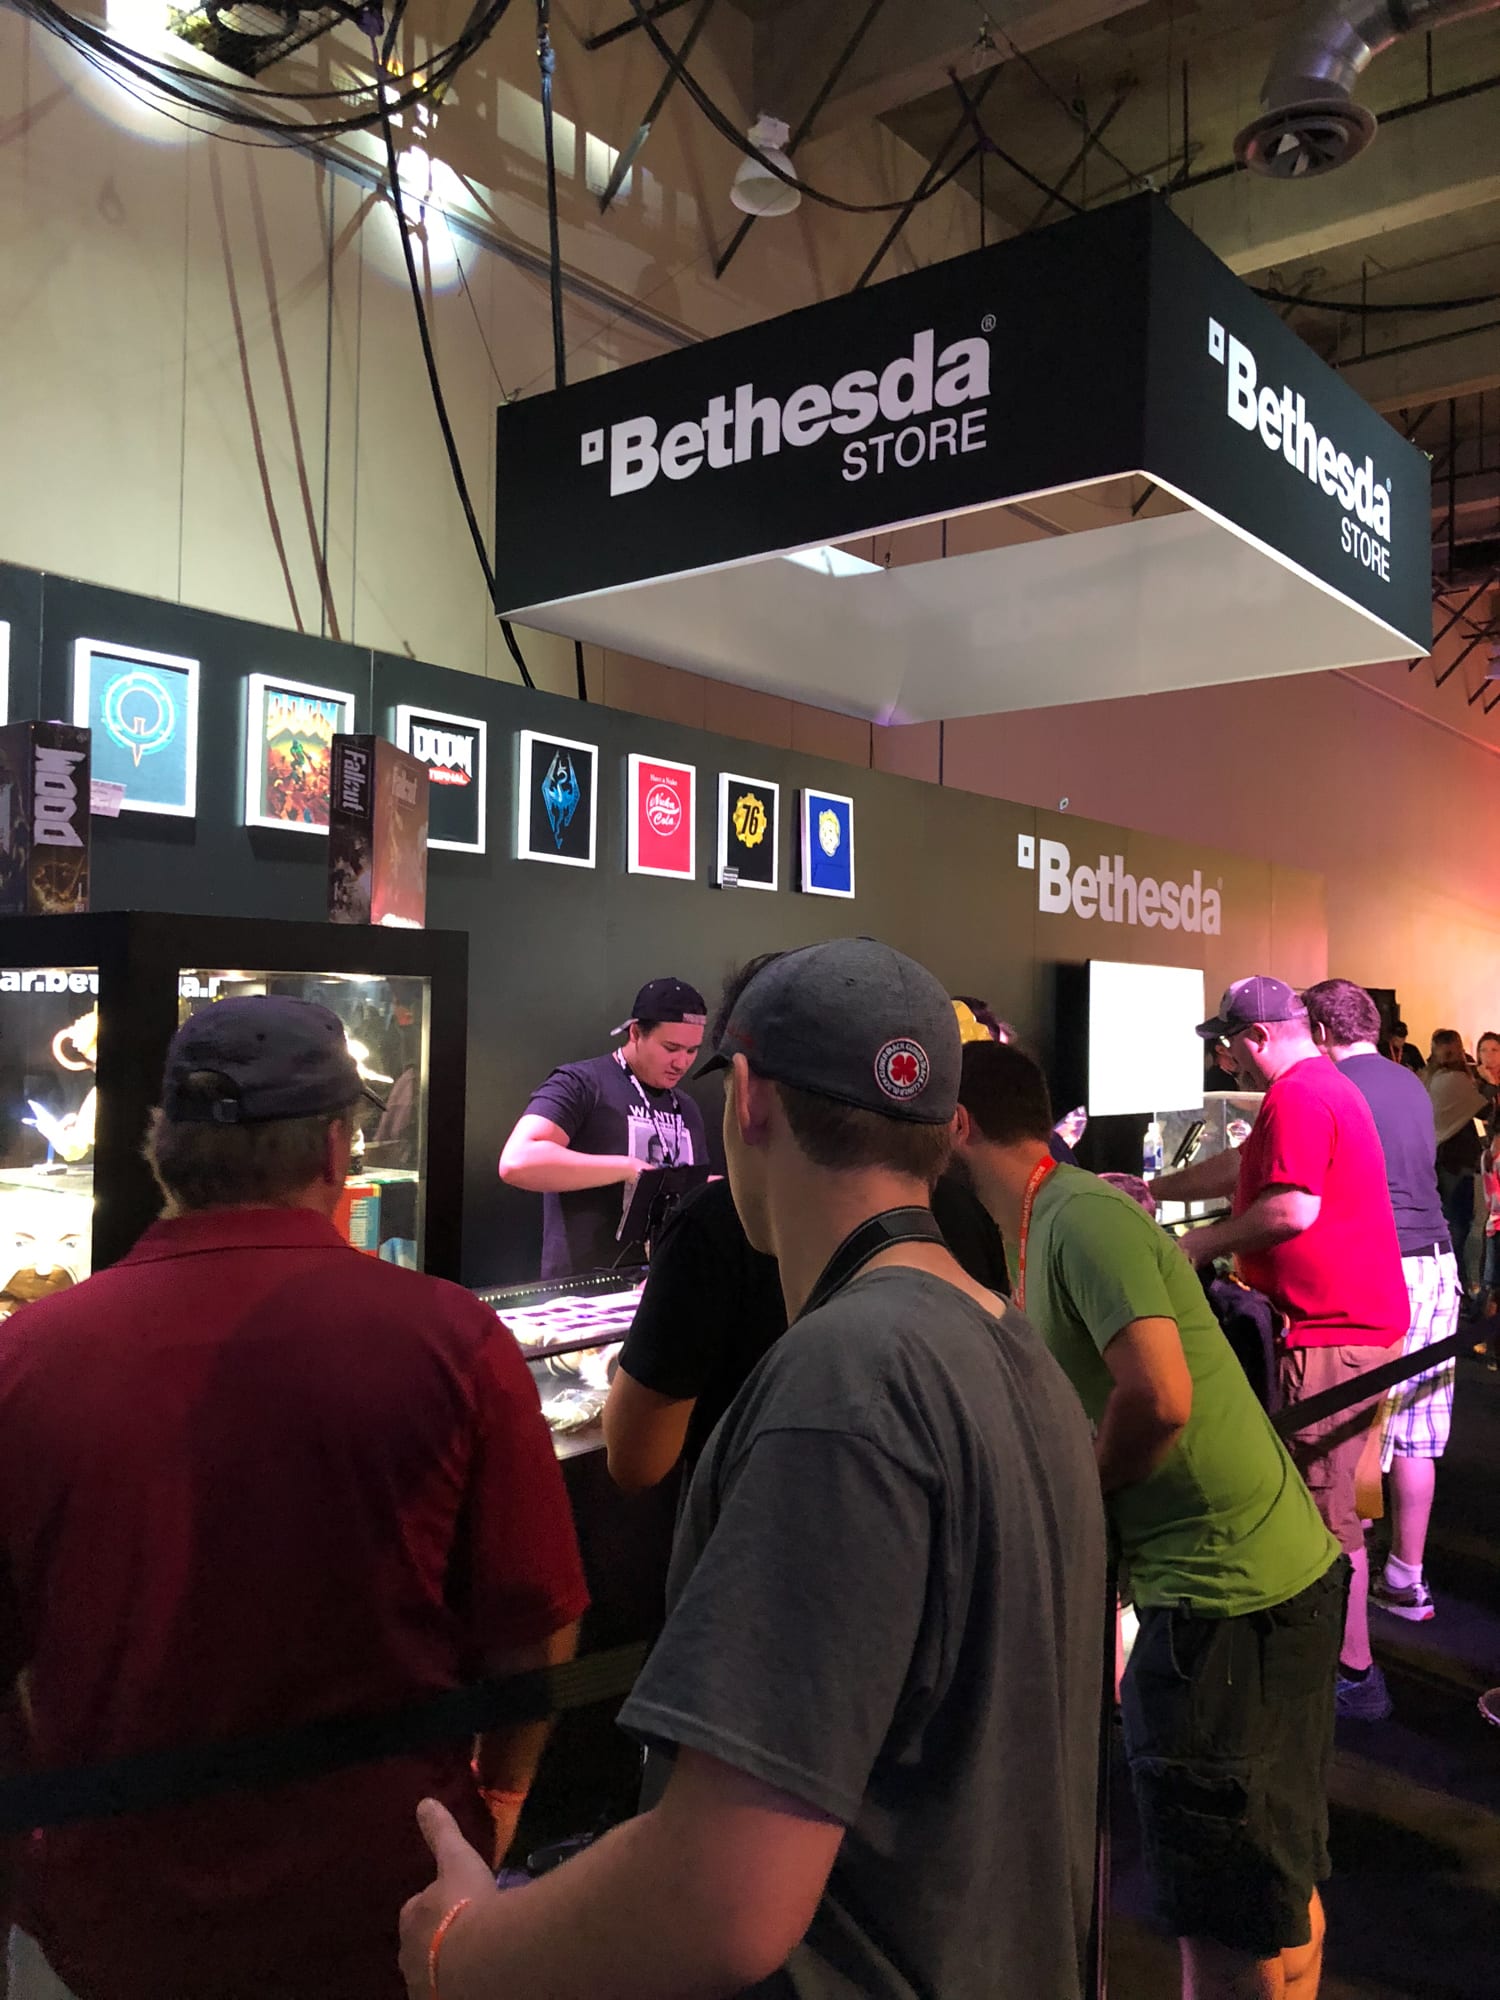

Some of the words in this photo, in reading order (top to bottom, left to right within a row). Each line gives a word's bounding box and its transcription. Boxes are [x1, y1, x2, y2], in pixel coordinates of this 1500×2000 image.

[841, 408, 988, 482] STORE
[1341, 516, 1391, 583] STORE
[342, 749, 367, 813] Fallout
[412, 725, 475, 779] DOOM
[34, 744, 86, 847] DOOM
[653, 812, 675, 825] Cola
[742, 804, 760, 835] 76
[1039, 838, 1222, 935] Bethesda
